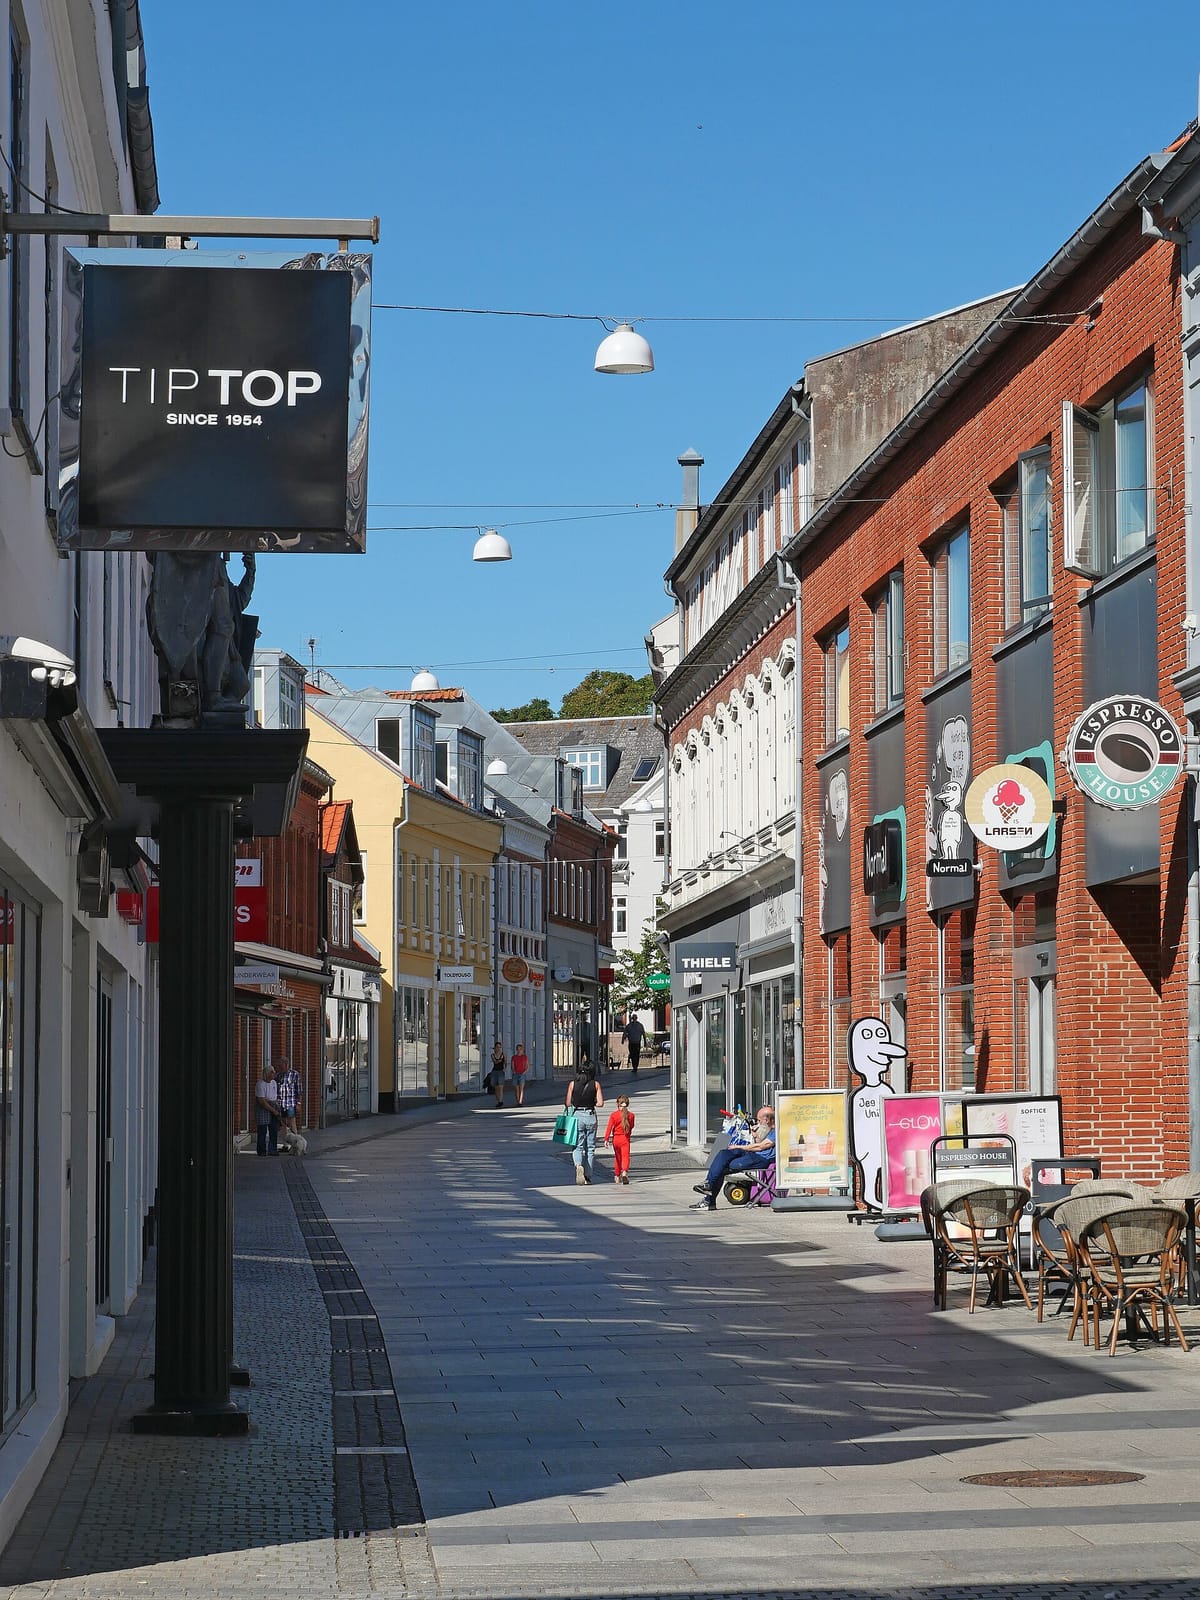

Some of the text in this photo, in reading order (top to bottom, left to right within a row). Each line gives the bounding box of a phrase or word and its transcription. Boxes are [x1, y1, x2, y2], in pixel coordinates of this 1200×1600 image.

[166, 413, 263, 427] SINCE 1954
[1079, 703, 1175, 744] ESPRESSO
[1089, 775, 1164, 802] HOUSE
[932, 862, 968, 874] Normal
[681, 957, 731, 968] THIELE
[649, 977, 665, 985] Louis
[858, 1097, 876, 1108] Jeg
[940, 1152, 1007, 1162] ESPRESSO HOUSE
